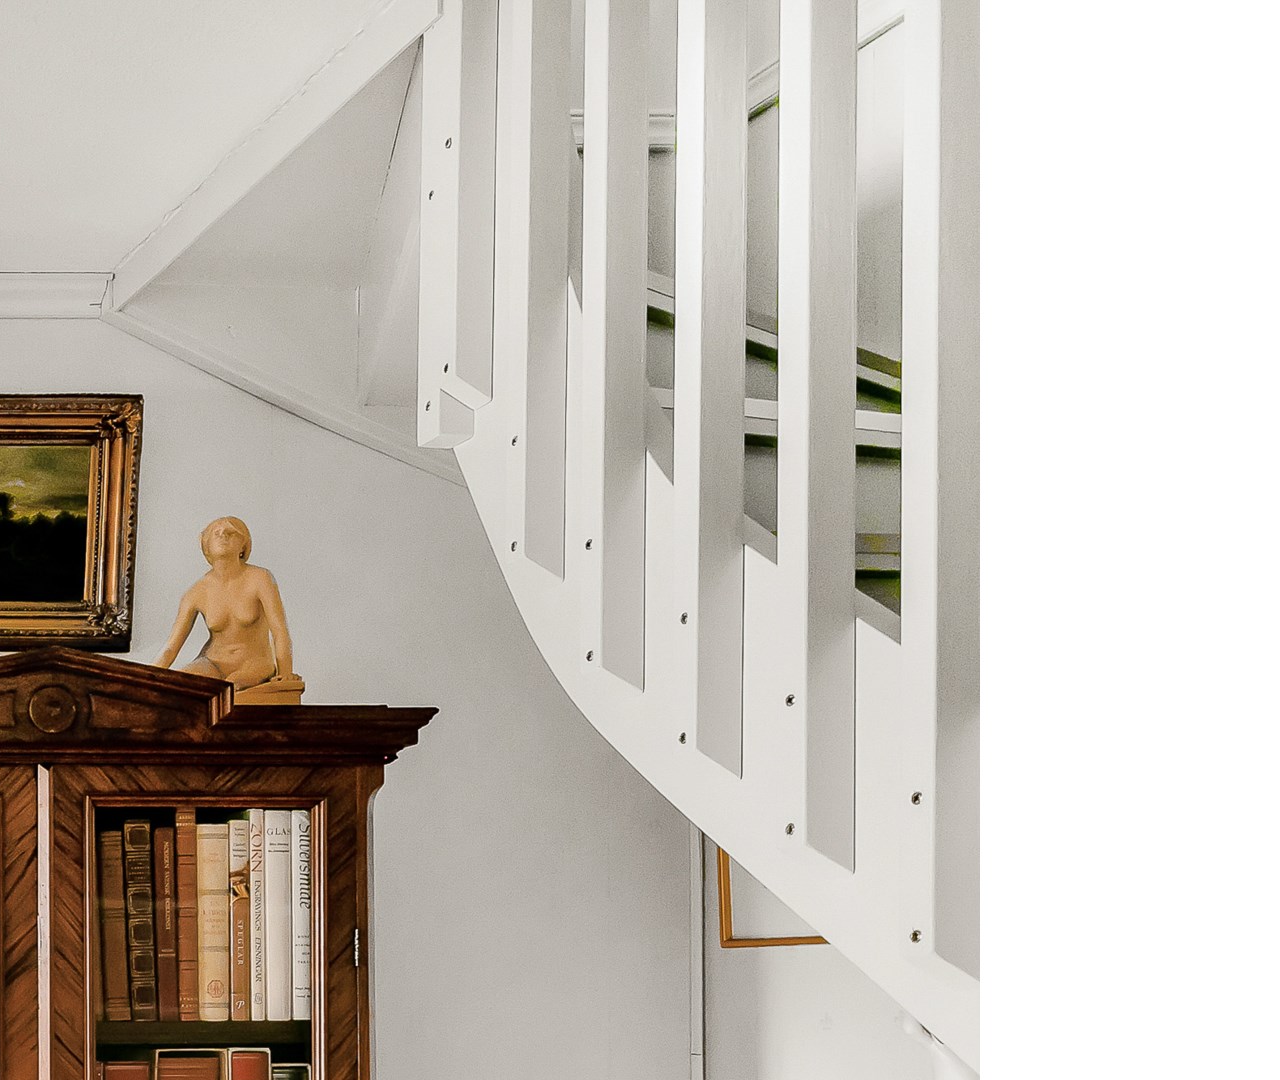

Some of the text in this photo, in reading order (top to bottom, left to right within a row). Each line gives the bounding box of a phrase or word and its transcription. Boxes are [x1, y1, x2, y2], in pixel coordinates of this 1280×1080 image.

[251, 823, 263, 983] ZORN ENGRAVINGS ETSNINGAR
